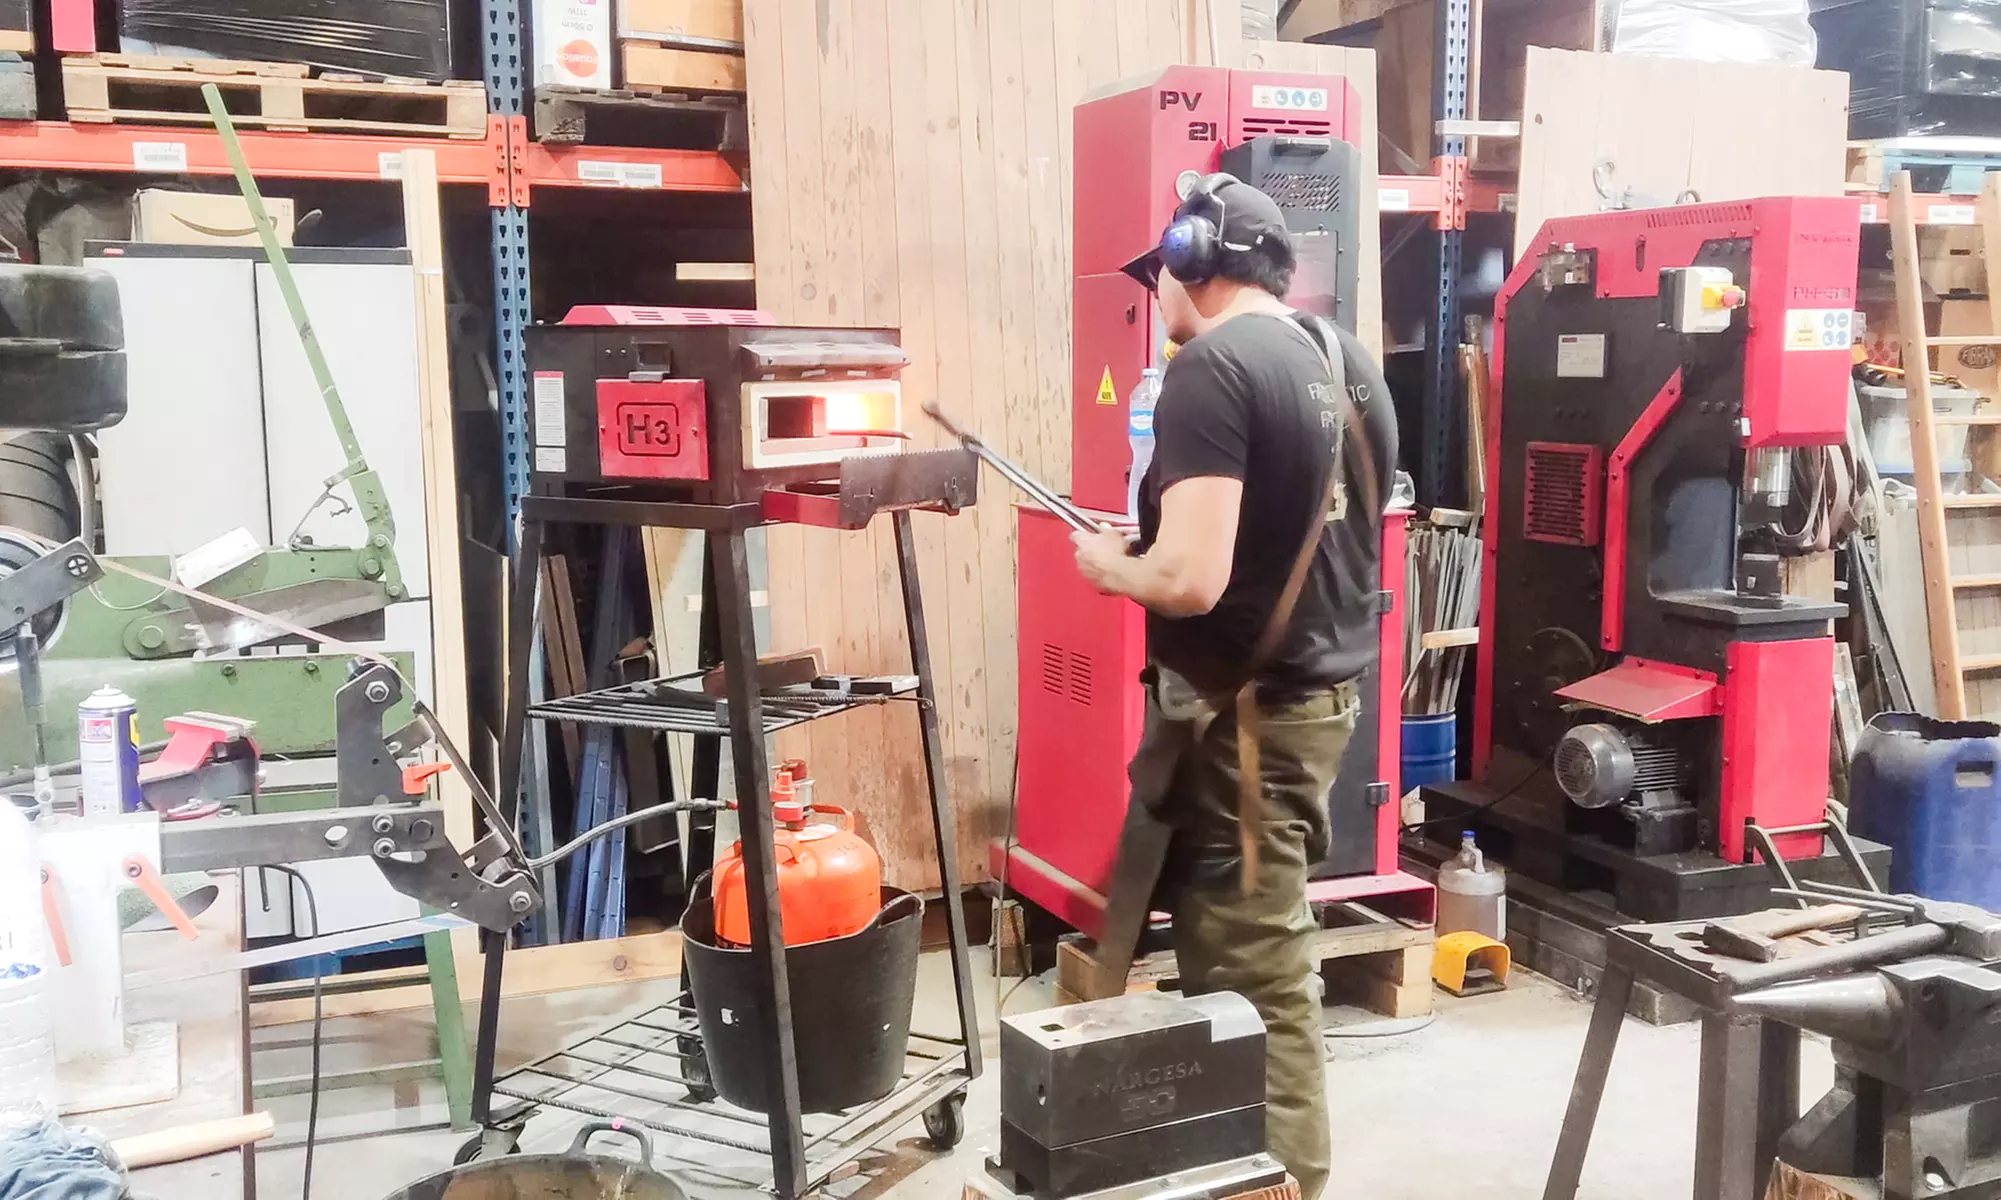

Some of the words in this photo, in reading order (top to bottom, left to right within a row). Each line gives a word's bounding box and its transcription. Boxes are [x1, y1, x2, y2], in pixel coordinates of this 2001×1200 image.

[1160, 90, 1202, 112] PV
[1188, 121, 1217, 142] 21
[627, 413, 672, 445] H3
